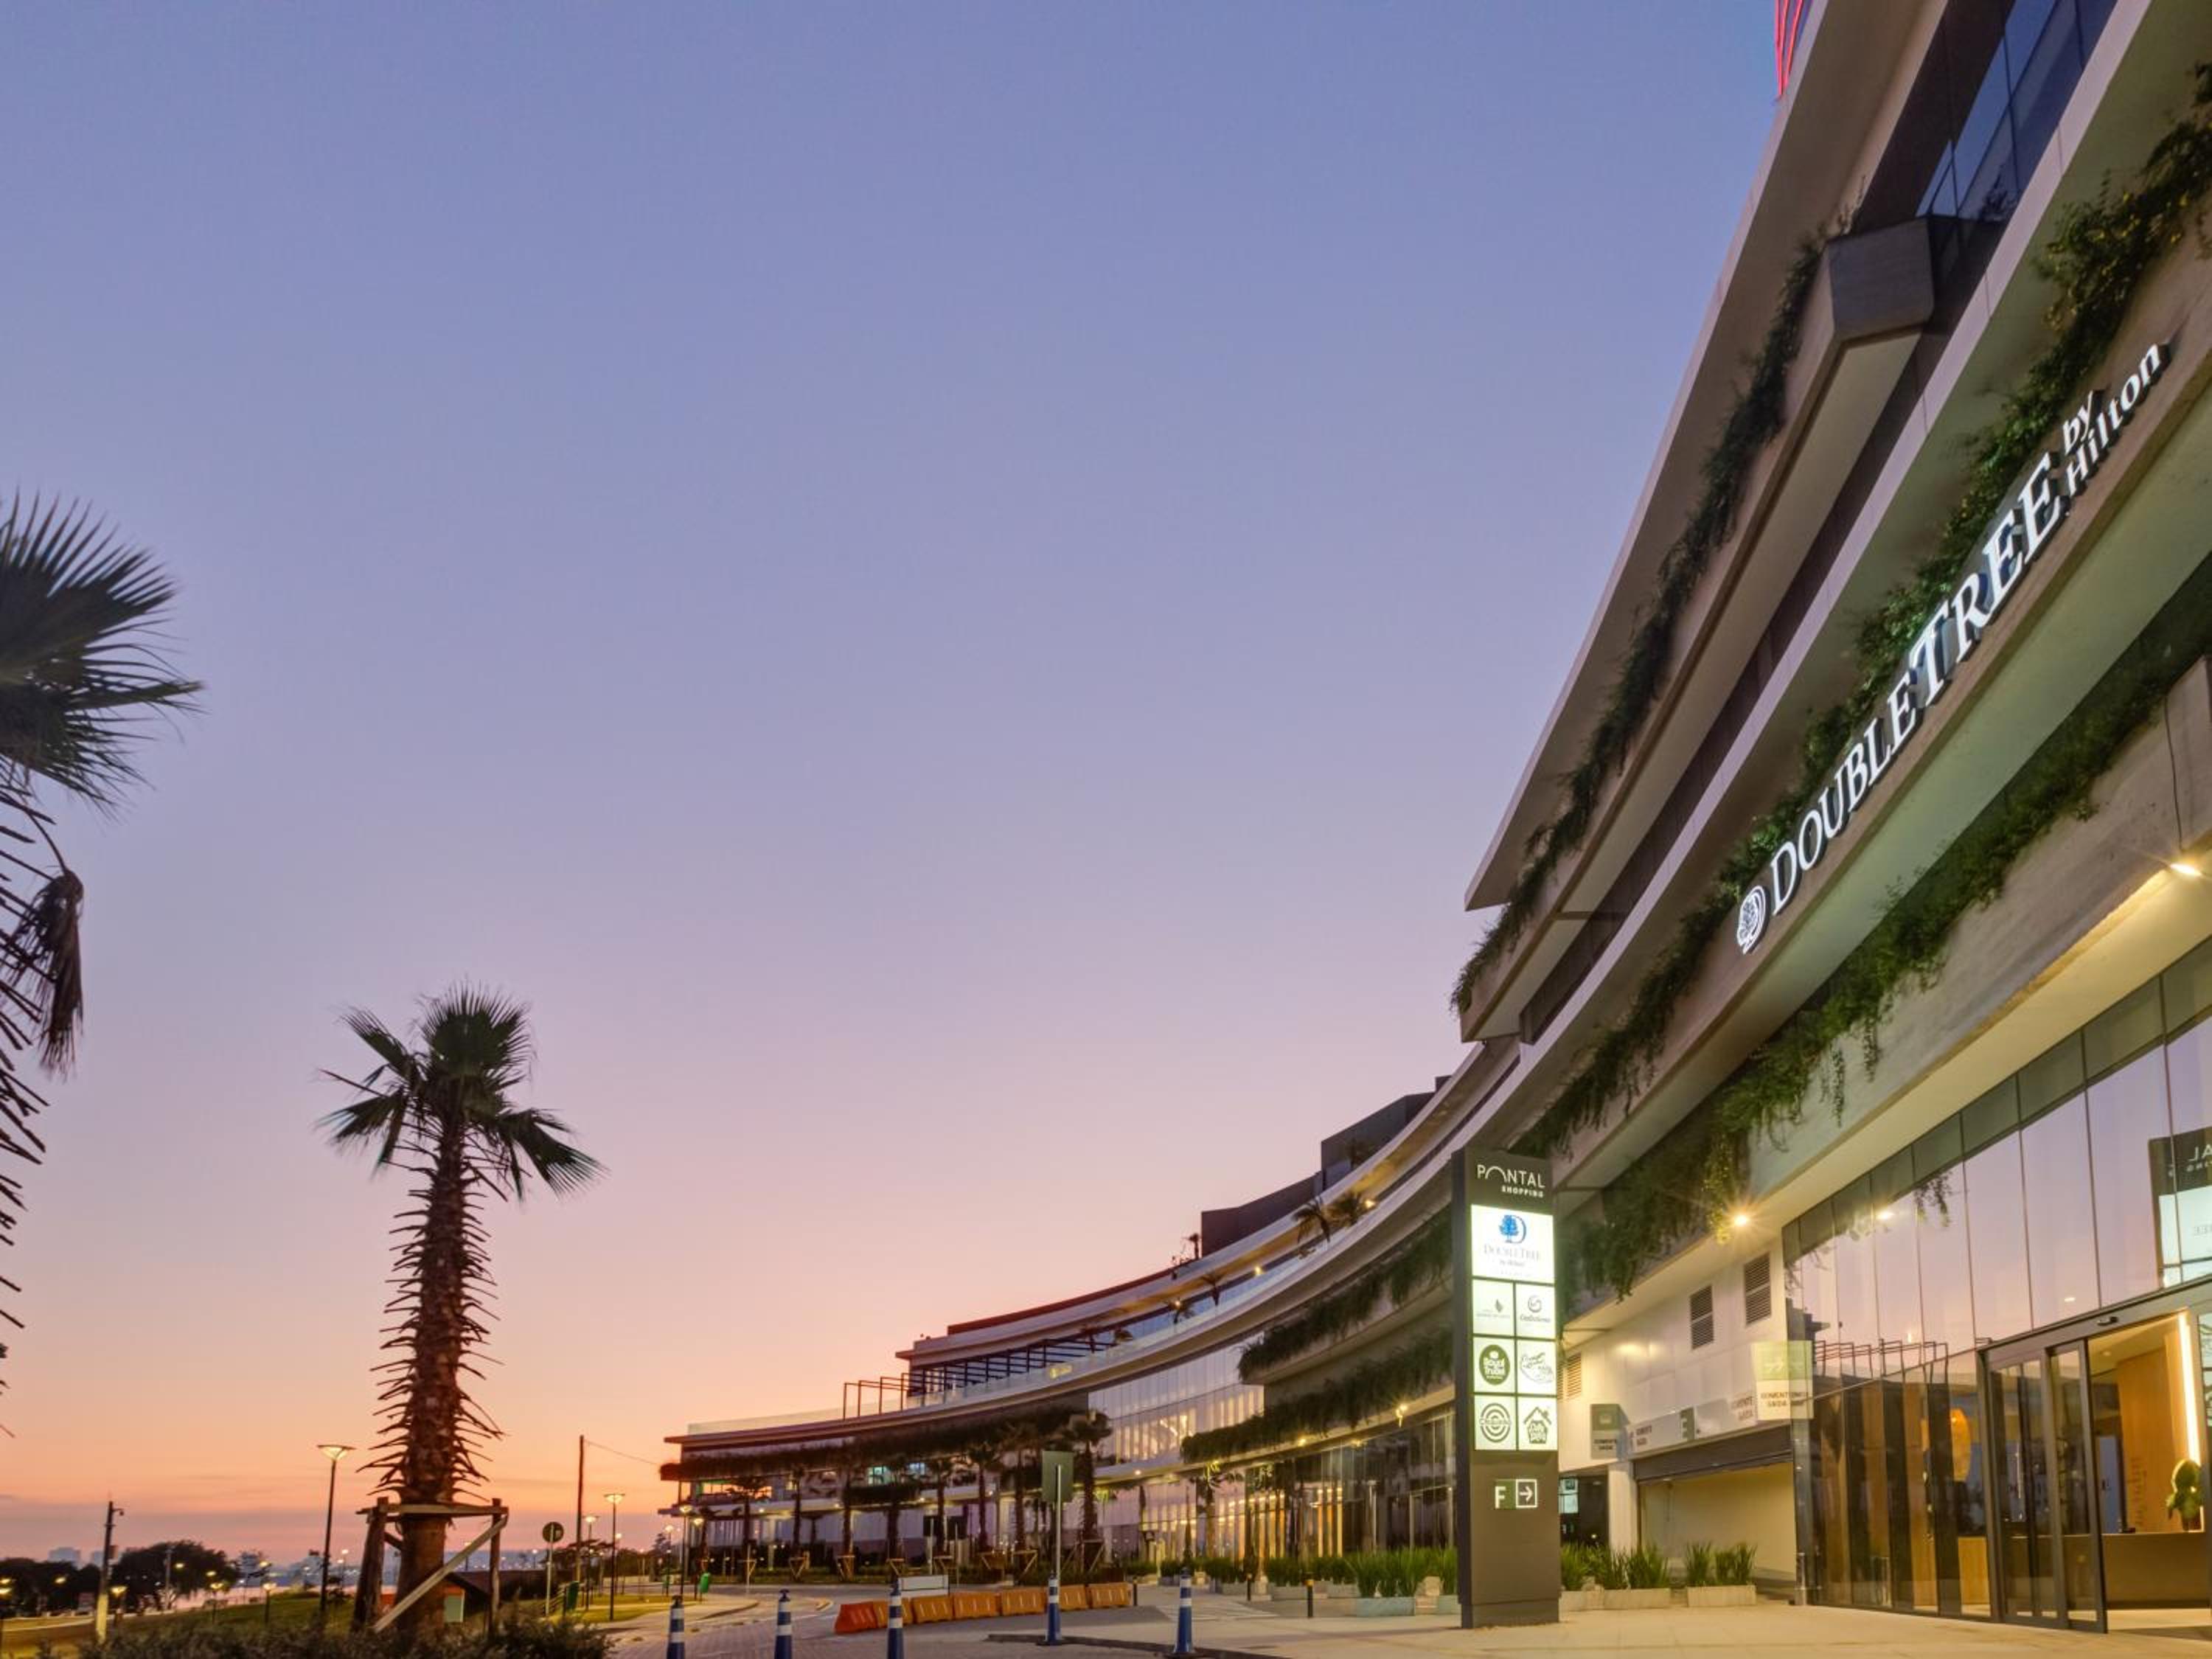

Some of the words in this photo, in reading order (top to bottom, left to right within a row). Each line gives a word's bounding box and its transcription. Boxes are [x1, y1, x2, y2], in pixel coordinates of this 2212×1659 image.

[2062, 390, 2093, 456] by
[2066, 344, 2160, 497] Hilton
[1770, 451, 2061, 917] DOUBLETREE
[1477, 1164, 1545, 1189] PONTAL
[1501, 1185, 1544, 1198] SHOPPING
[1495, 1486, 1506, 1509] F
